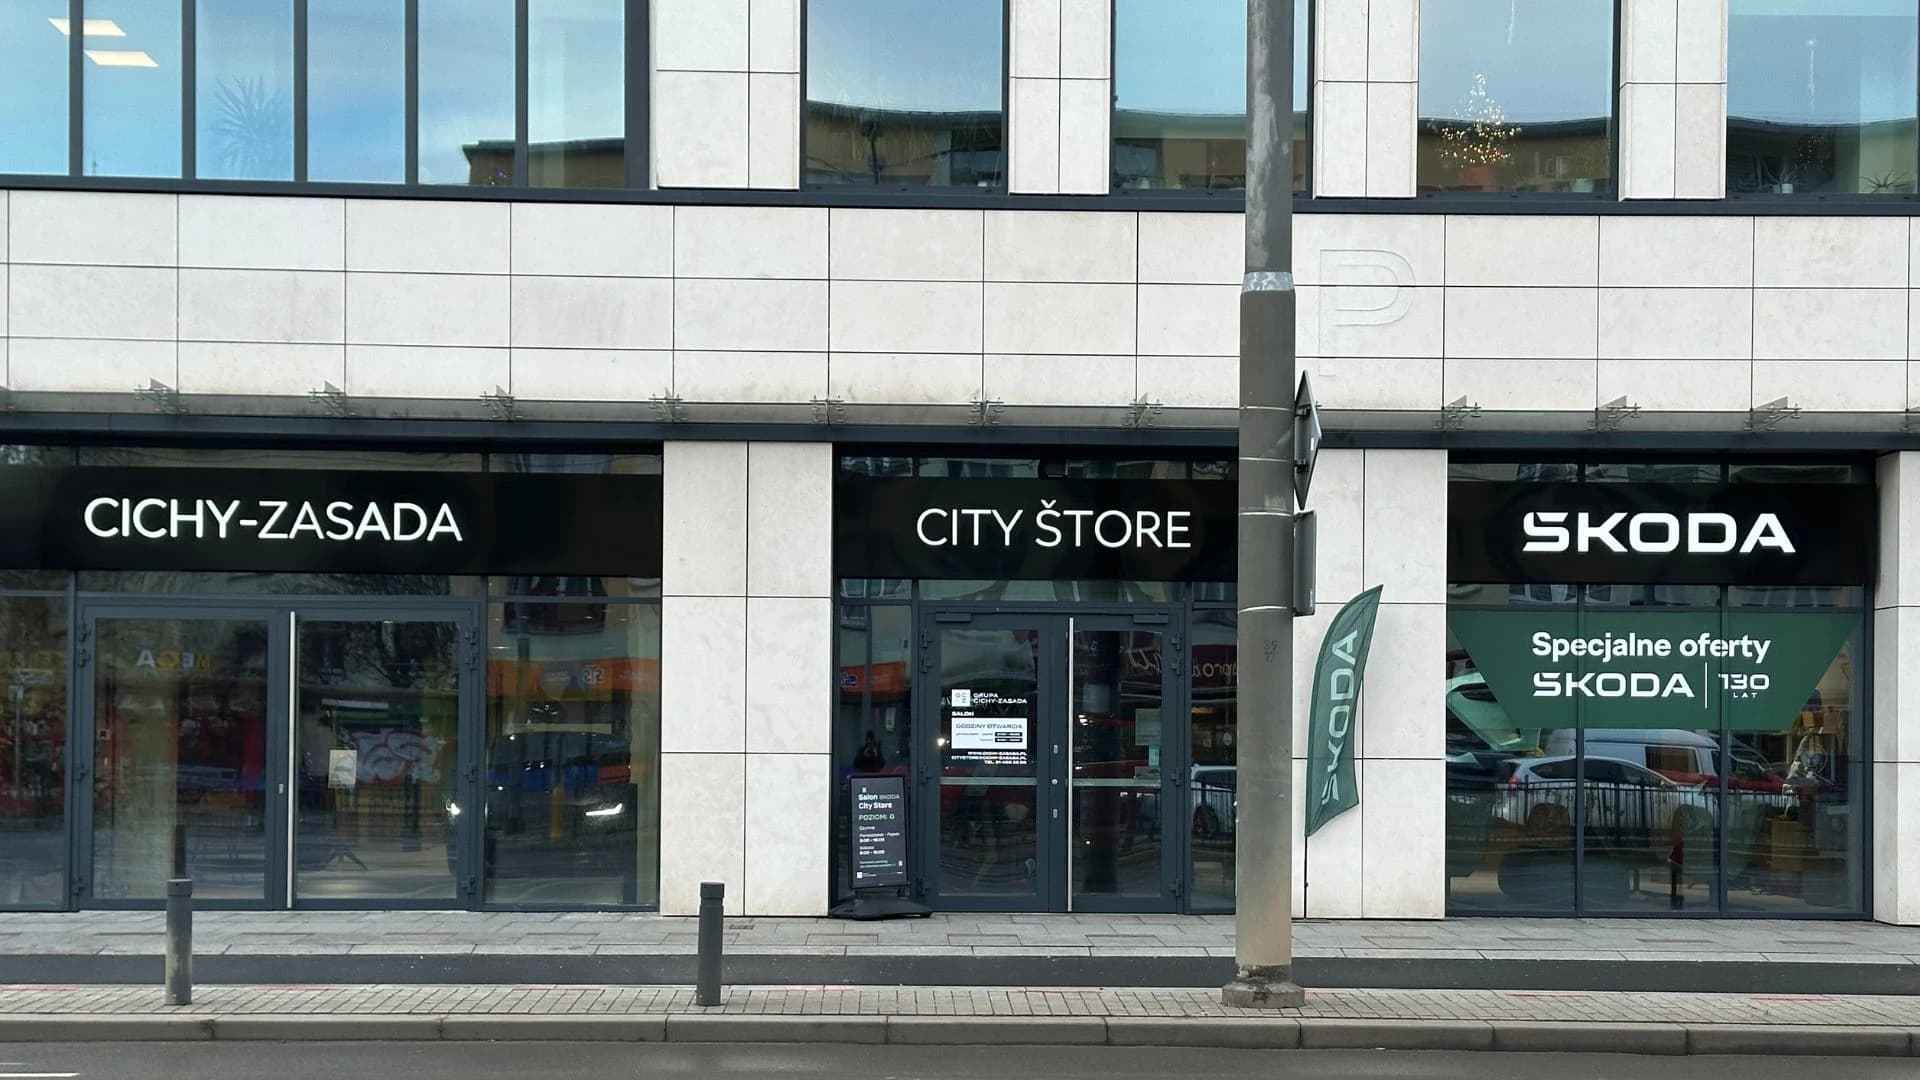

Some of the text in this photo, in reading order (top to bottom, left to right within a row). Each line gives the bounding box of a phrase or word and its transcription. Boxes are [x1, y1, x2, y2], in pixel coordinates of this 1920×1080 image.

[1319, 249, 1415, 376] P
[84, 497, 463, 542] CICHY-ZASADA
[916, 499, 1192, 548] CITY ŠTORE
[1532, 631, 1771, 664] Specjalne oferty
[1718, 673, 1770, 690] 130
[858, 793, 878, 801] Salon
[858, 802, 872, 810] City
